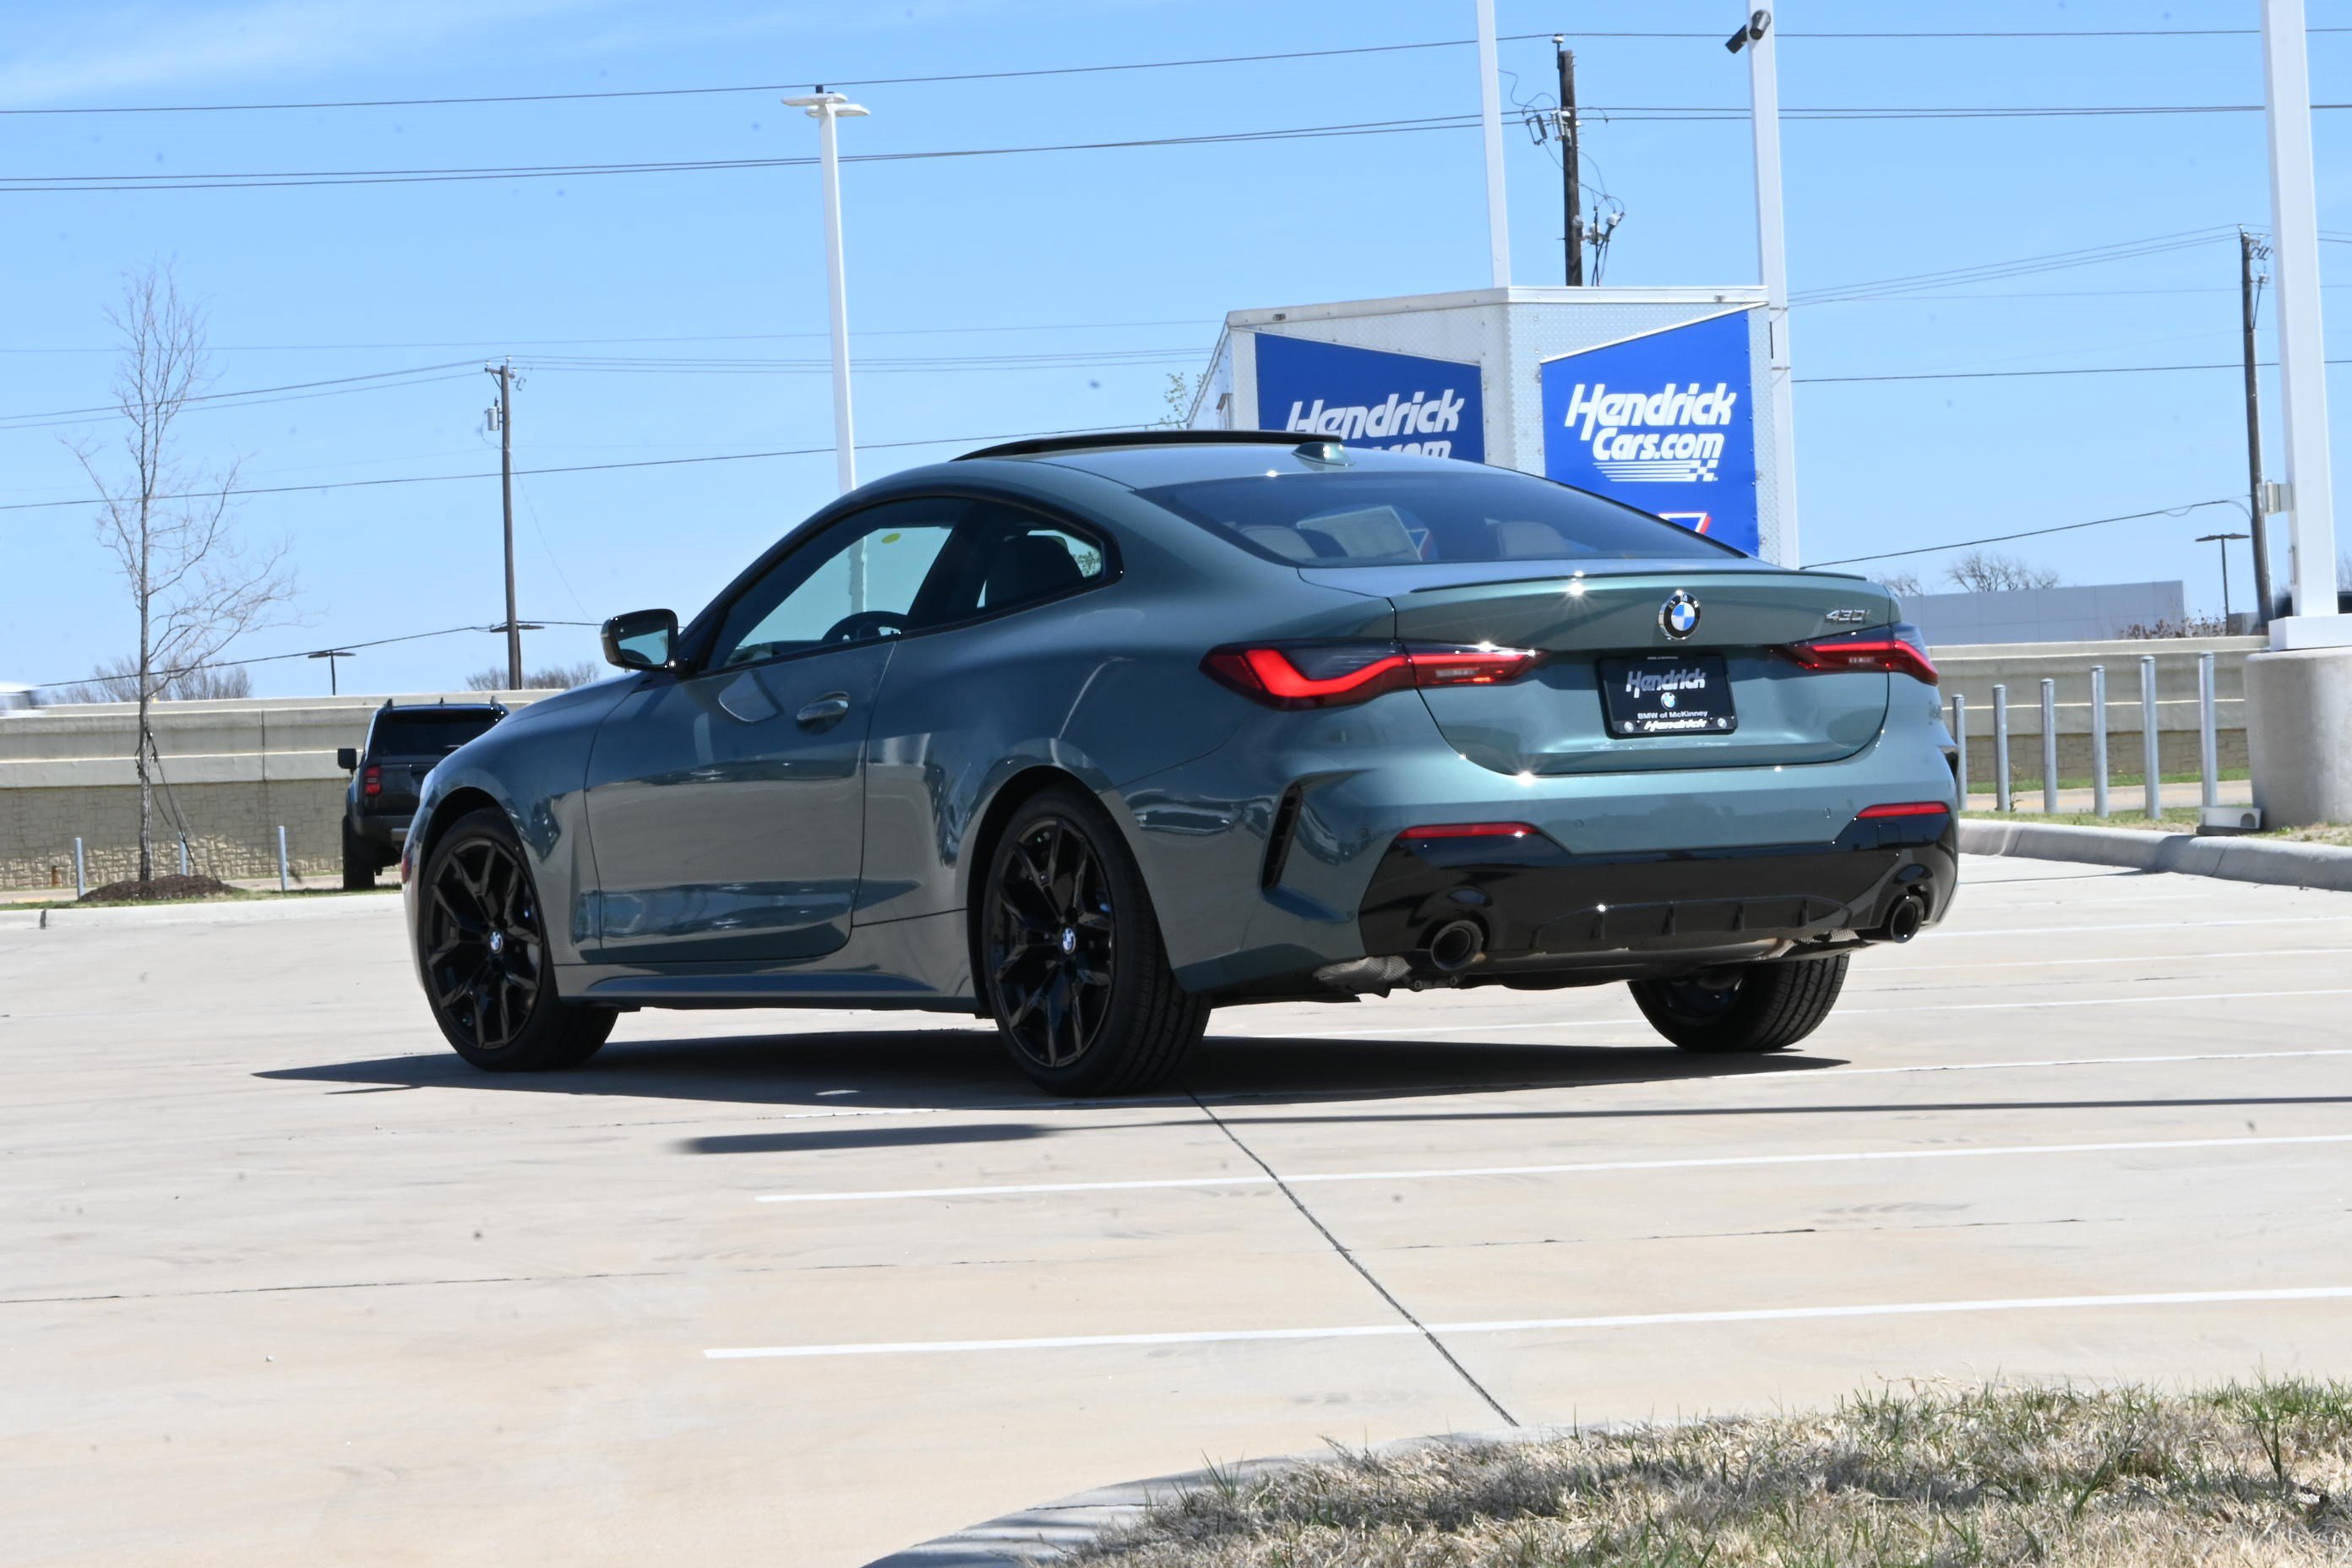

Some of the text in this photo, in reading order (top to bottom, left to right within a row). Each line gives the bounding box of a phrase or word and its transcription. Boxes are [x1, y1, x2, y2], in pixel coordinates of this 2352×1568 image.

[1285, 389, 1465, 440] Hendrick
[1565, 383, 1737, 441] Hendrick
[1592, 427, 1725, 461] Cars.com
[1625, 667, 1707, 699] Hendrick
[1669, 710, 1708, 719] McKinney
